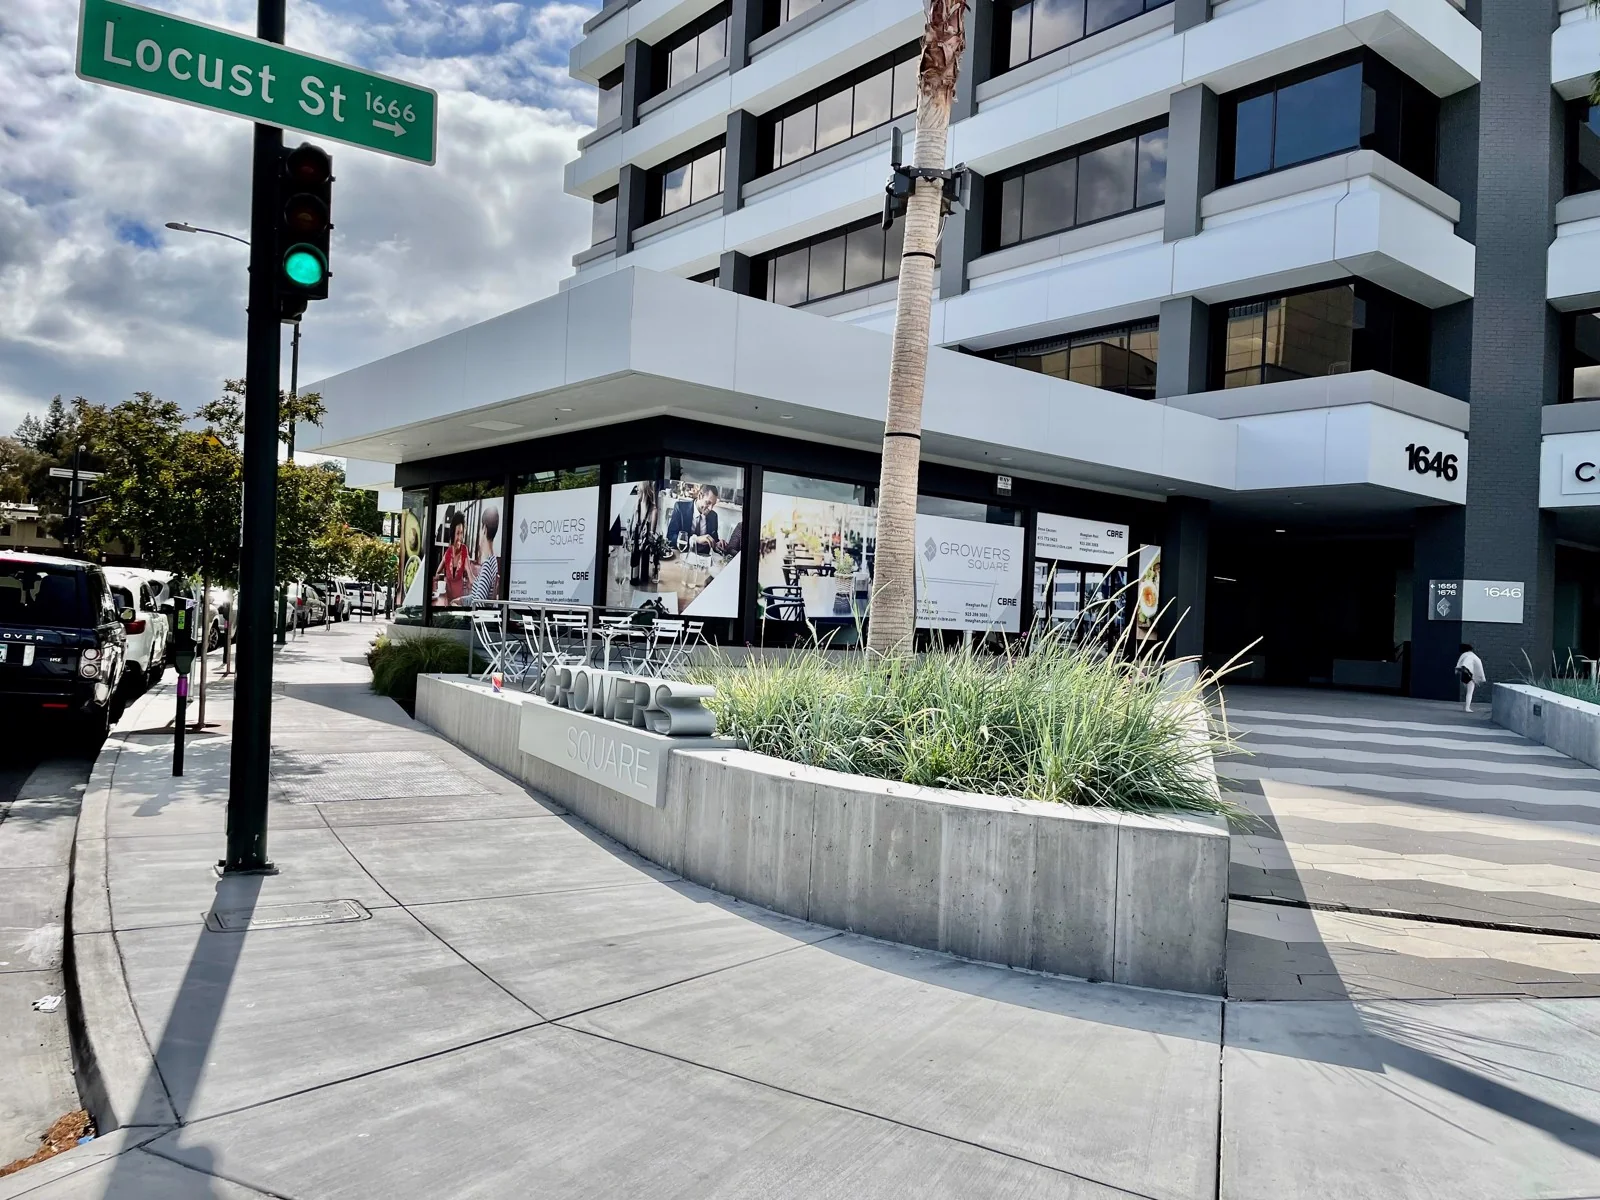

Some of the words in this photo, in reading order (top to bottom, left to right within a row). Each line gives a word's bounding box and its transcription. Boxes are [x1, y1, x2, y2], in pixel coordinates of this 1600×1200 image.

[103, 20, 276, 104] Locust
[298, 75, 347, 123] St
[364, 91, 417, 123] 1666
[1405, 443, 1459, 482] 1646
[1575, 461, 1600, 482] C
[529, 517, 586, 534] GROWERS
[1106, 529, 1124, 539] CBRE
[549, 533, 585, 546] SQUARE
[939, 541, 1011, 562] GROWERS
[967, 558, 1009, 573] SQUARE
[571, 571, 590, 581] CBRE
[1483, 586, 1522, 598] 1646
[997, 597, 1018, 607] CBRE
[3, 633, 44, 641] OVER
[545, 664, 716, 736] GROWERS
[566, 725, 651, 789] SQUARE
